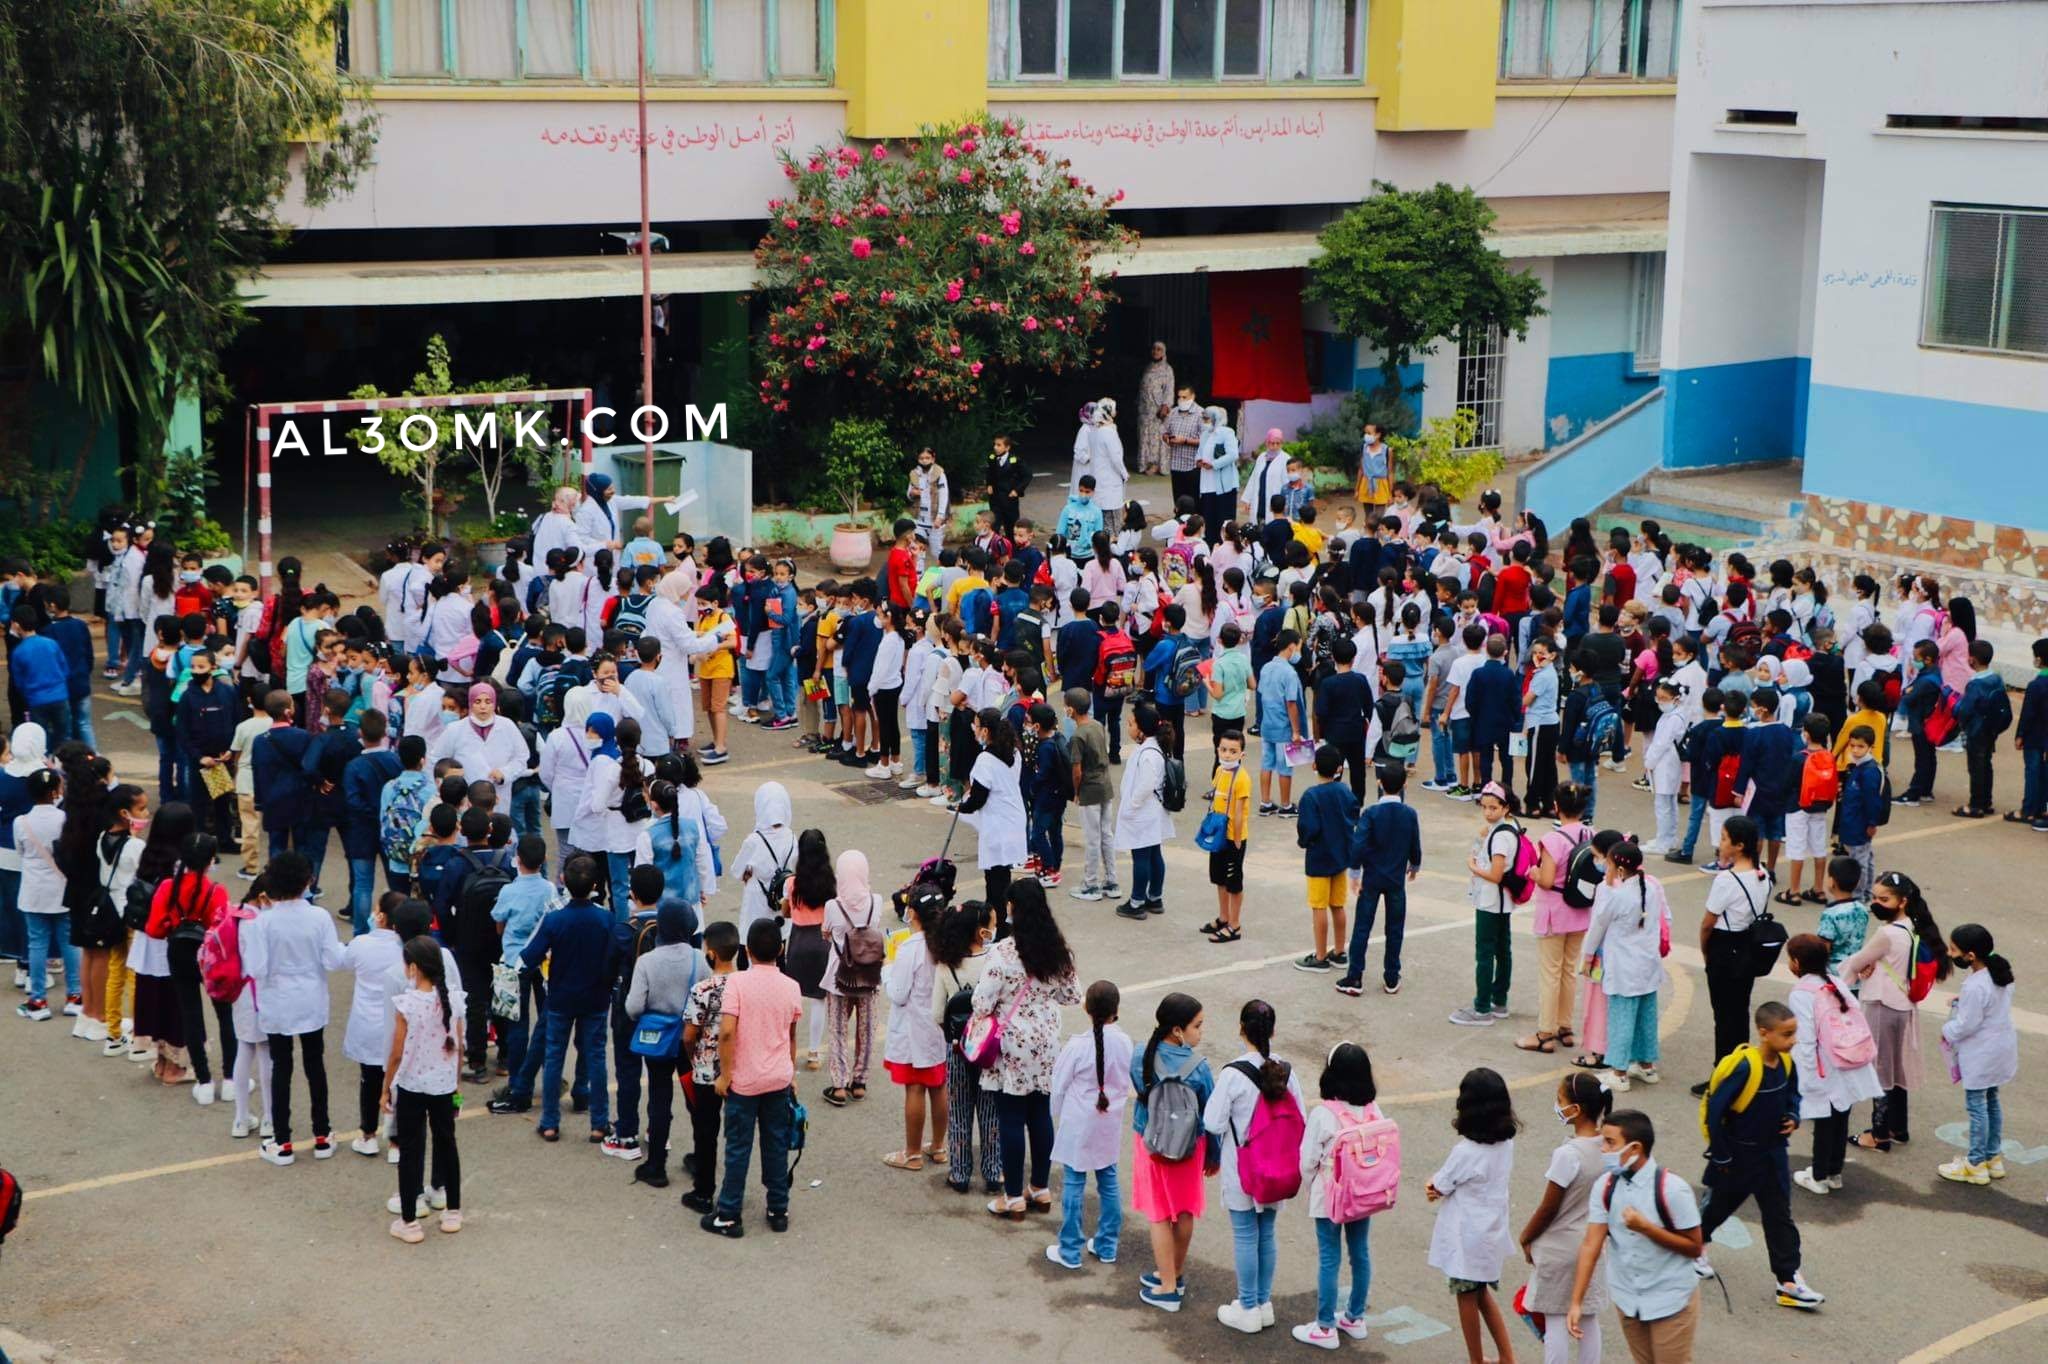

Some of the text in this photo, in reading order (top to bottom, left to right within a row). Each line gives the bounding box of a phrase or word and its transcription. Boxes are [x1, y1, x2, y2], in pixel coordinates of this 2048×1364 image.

[660, 124, 675, 154] في
[677, 122, 725, 151] الوطن
[729, 112, 767, 149] أمل
[1143, 118, 1155, 147] في
